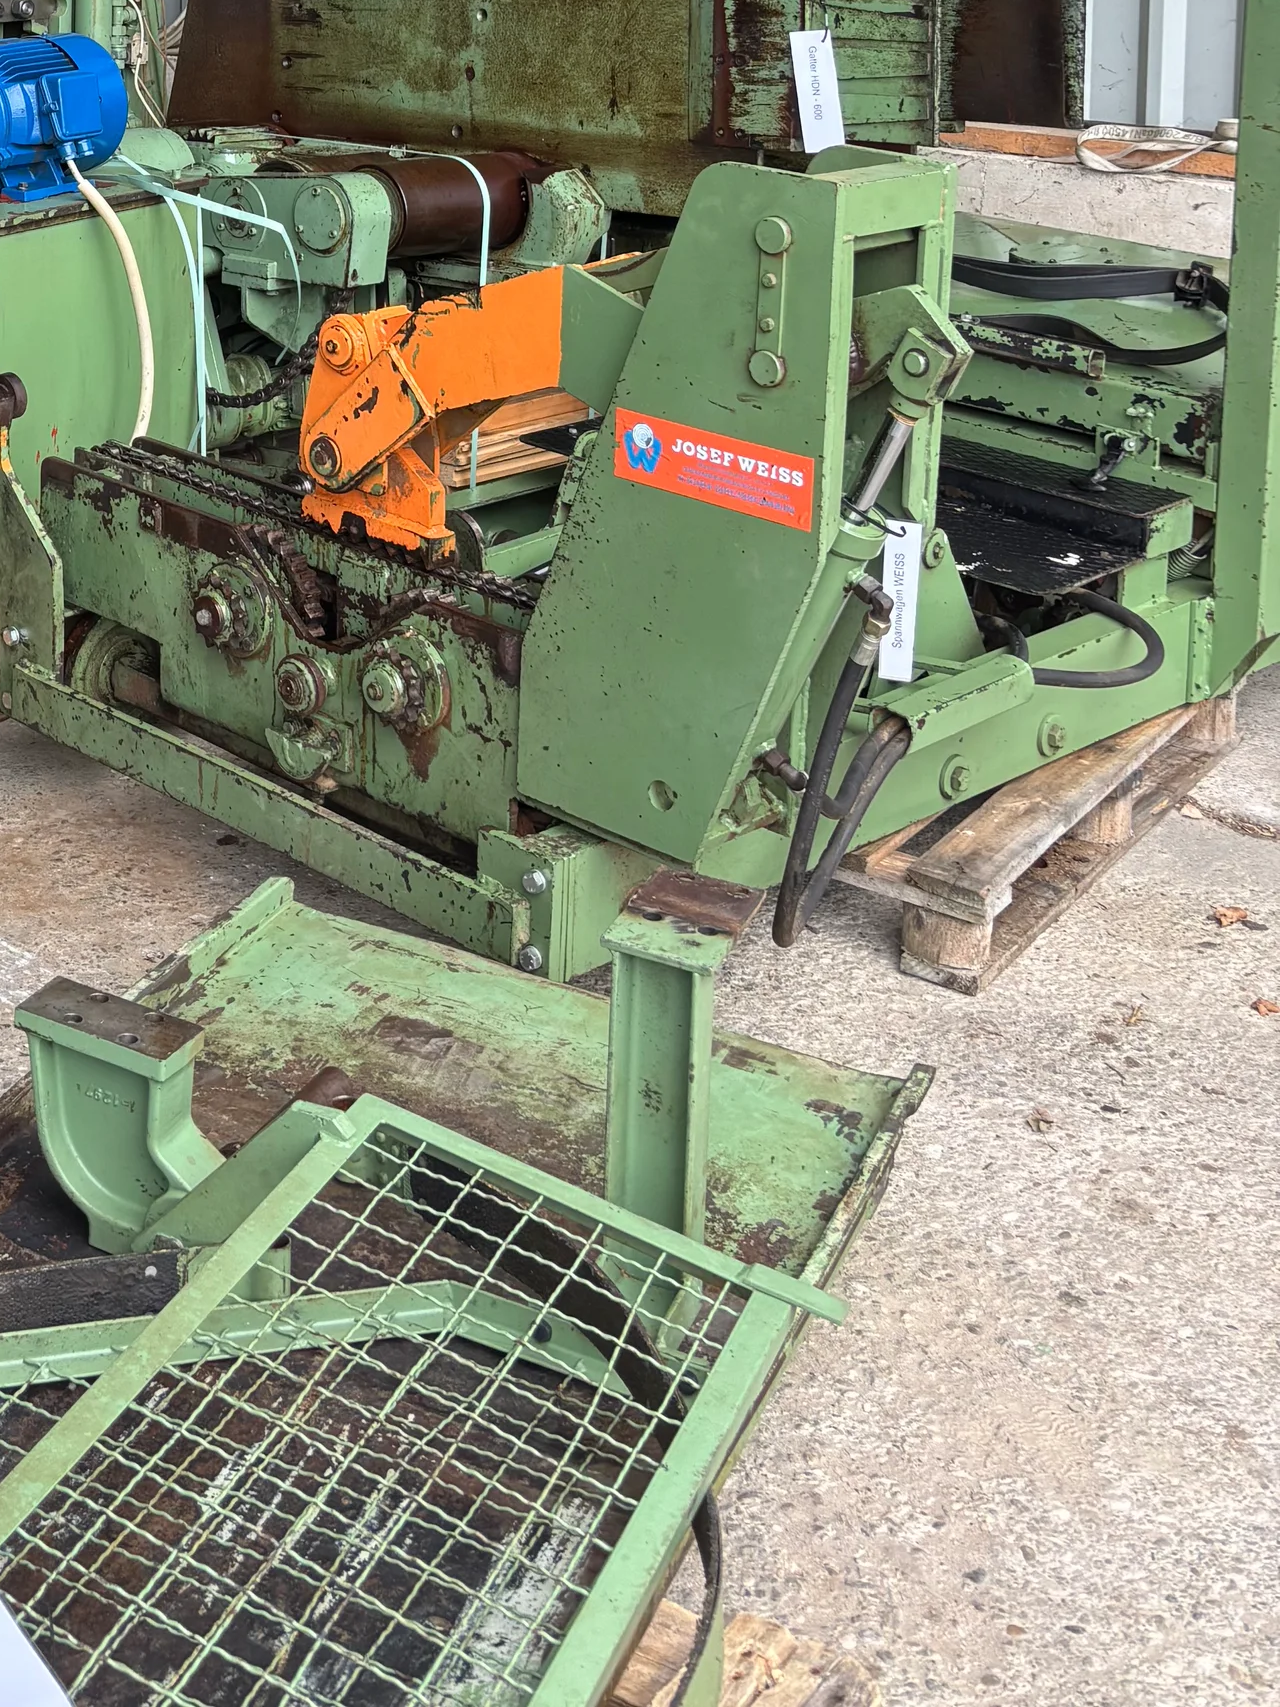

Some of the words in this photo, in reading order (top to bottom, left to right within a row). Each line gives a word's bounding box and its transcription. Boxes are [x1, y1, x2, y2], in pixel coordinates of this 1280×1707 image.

[808, 45, 818, 73] Gatter
[811, 75, 821, 96] HDN
[813, 104, 823, 121] 600
[671, 438, 736, 468] JOSEF
[736, 454, 804, 488] WEISS
[893, 553, 906, 587] WEISS
[891, 589, 906, 649] Spannwagen
